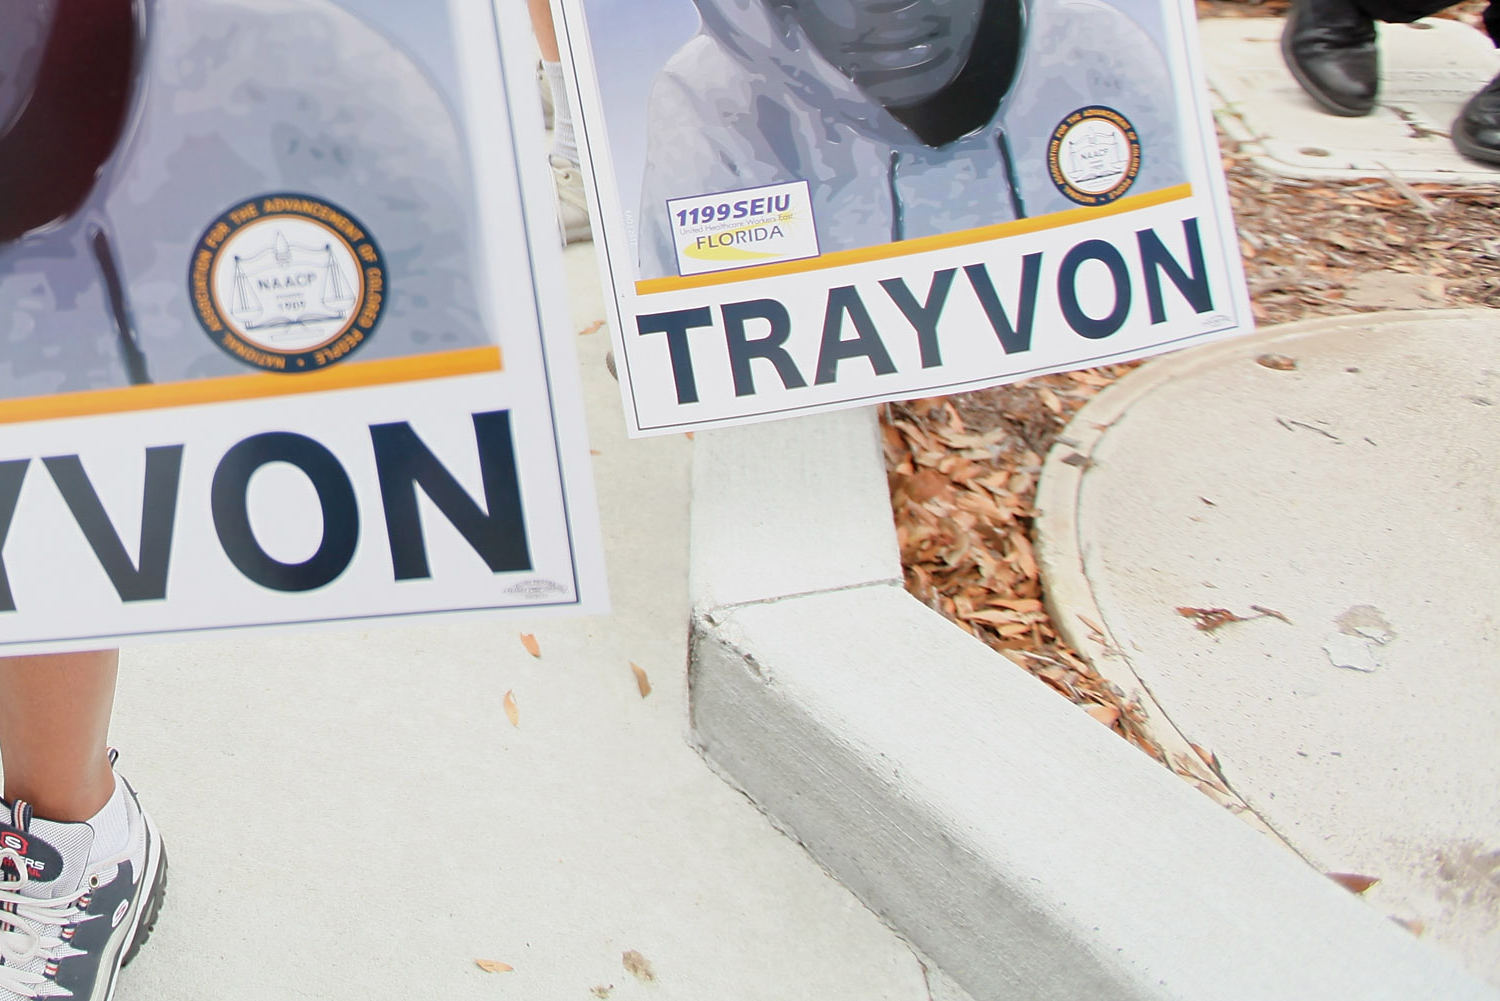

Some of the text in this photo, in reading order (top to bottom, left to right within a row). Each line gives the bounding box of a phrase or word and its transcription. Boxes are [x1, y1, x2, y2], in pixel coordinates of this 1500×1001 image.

[229, 203, 259, 225] THE
[263, 197, 365, 242] ADVANCEMENT
[676, 194, 790, 226] 1199SEIU
[205, 222, 231, 249] FOR
[696, 225, 784, 250] FLORIDA
[357, 243, 378, 262] OF
[258, 273, 317, 291] NAACP
[357, 267, 383, 329] COLORED
[635, 217, 1214, 405] TRAYVON
[220, 332, 286, 369] NATIONAL
[313, 329, 364, 365] PEOPLE
